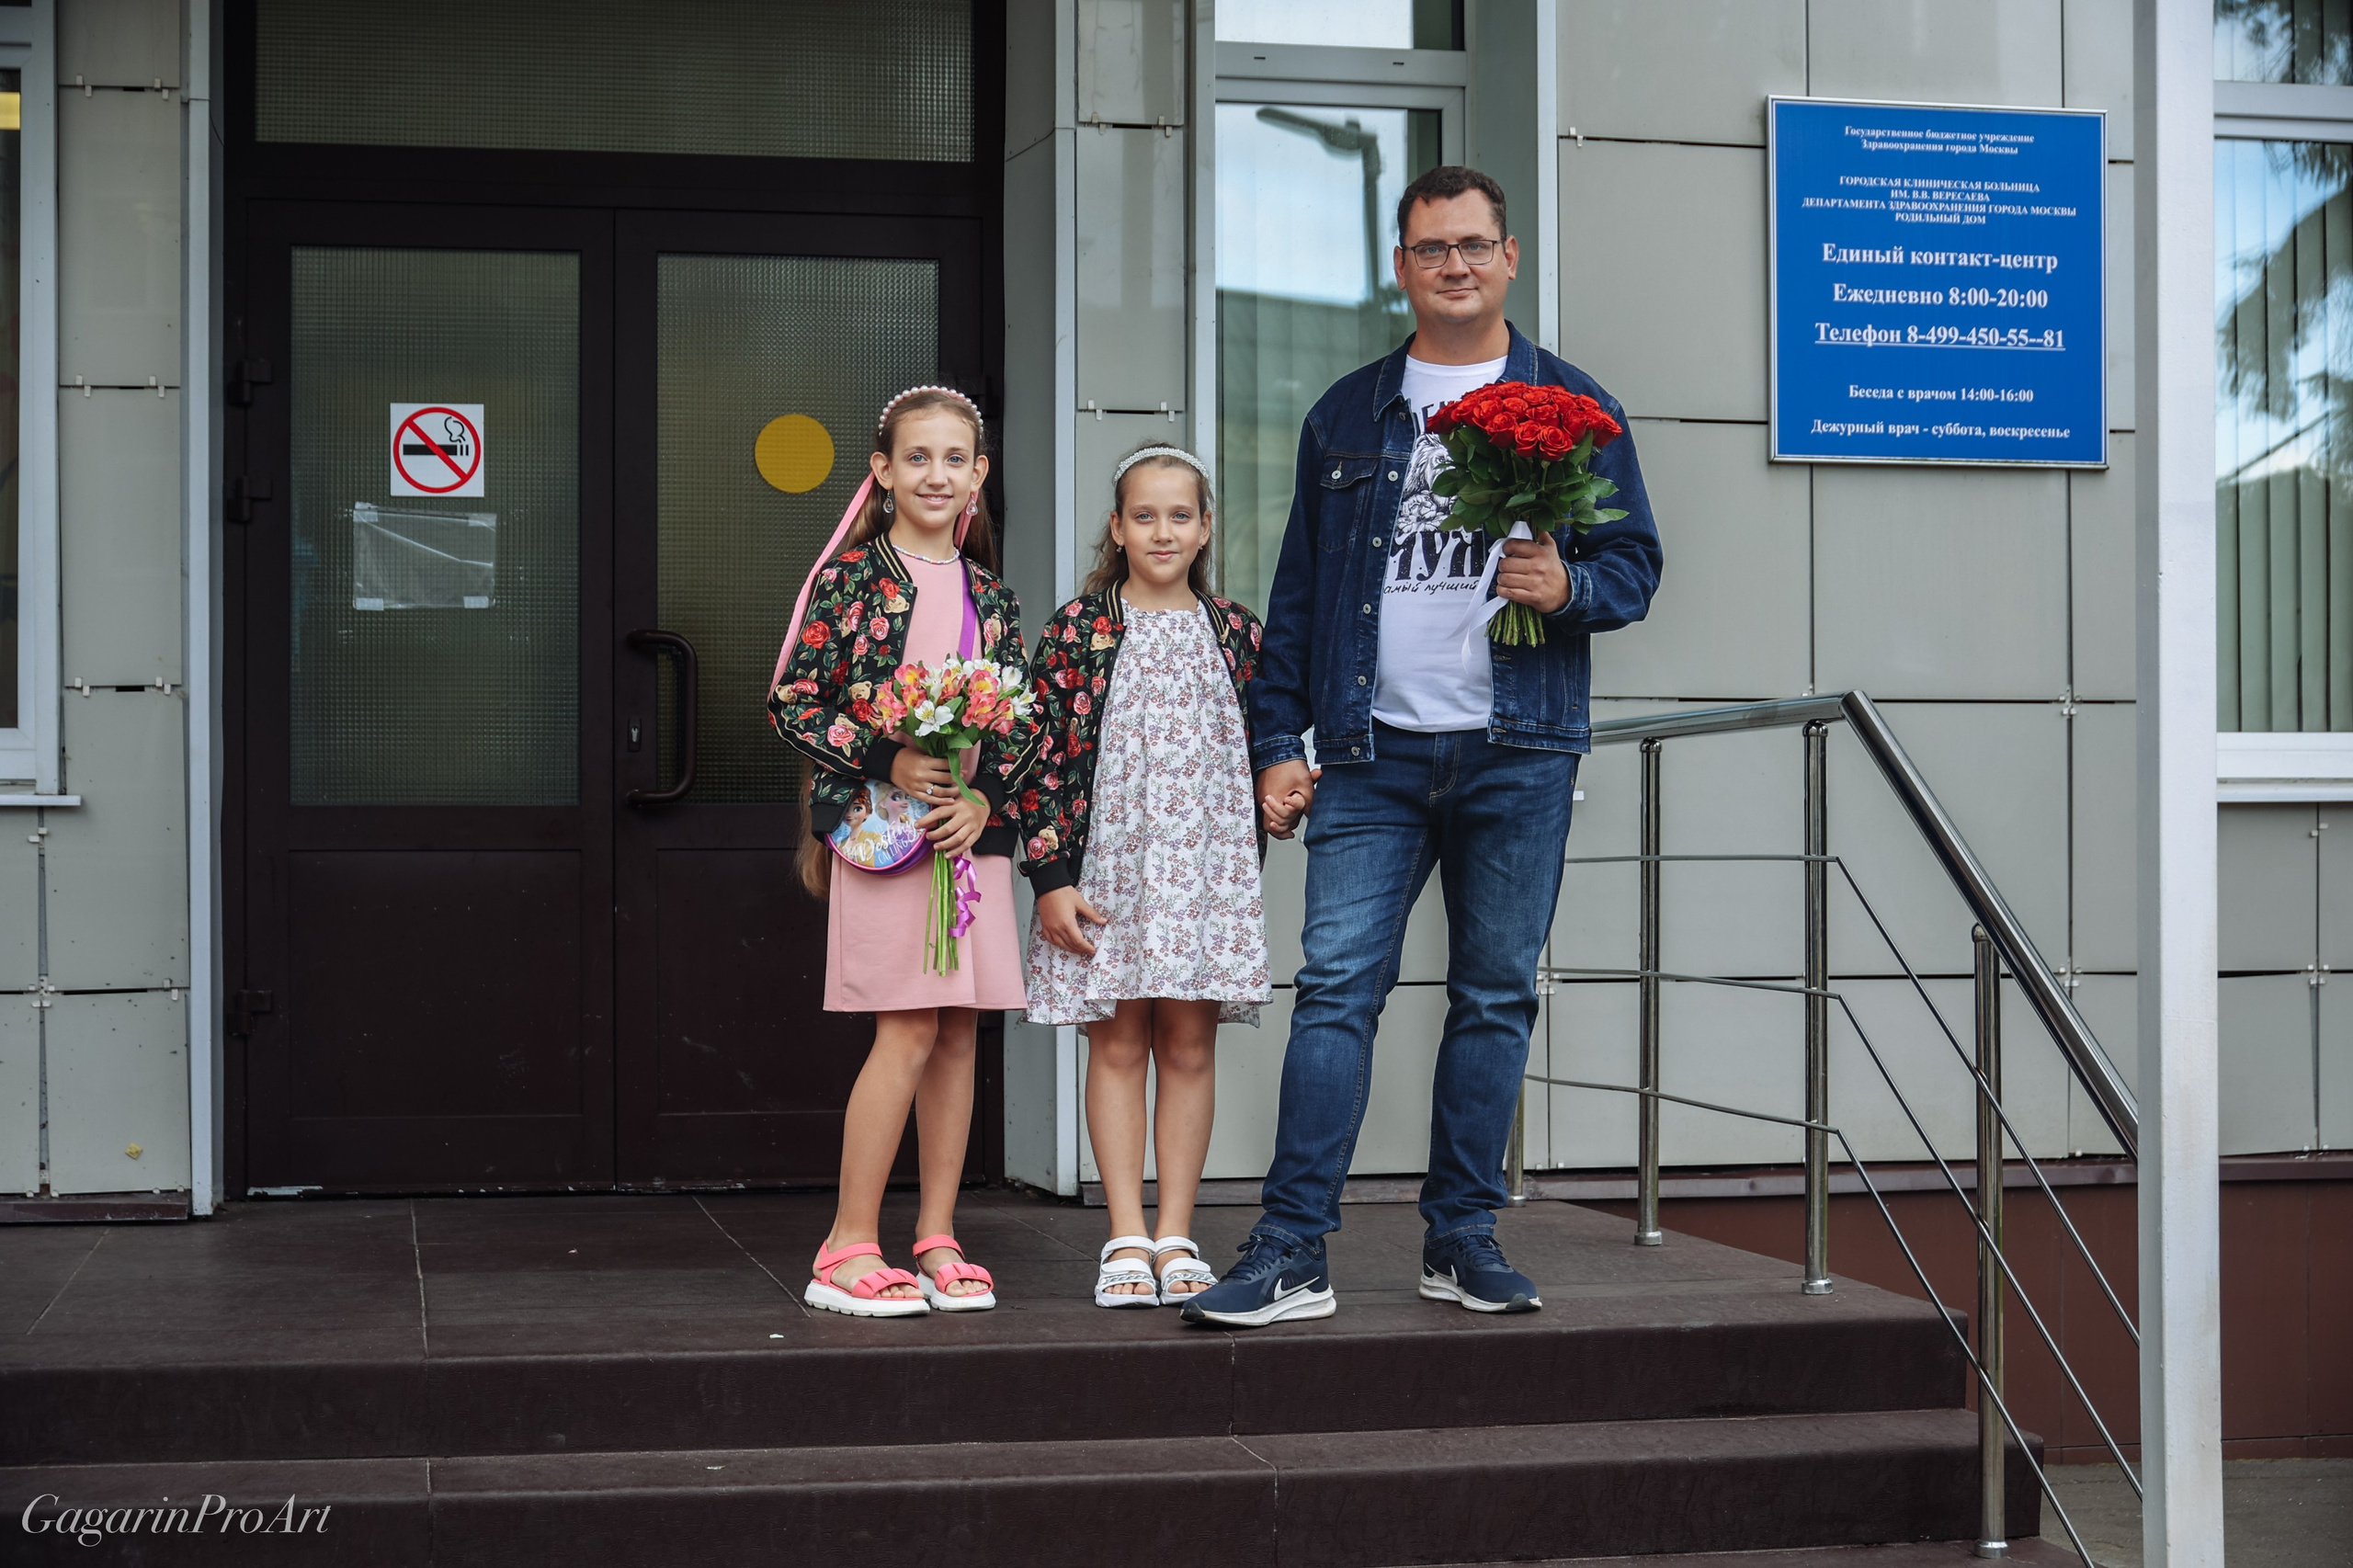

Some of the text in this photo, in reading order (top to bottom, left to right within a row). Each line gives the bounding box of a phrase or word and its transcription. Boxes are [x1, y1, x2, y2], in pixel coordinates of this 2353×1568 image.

[1844, 125, 2035, 143] Государственное бюджетное учреждение
[1860, 139, 2018, 154] Здравоохранения города Москвы
[1839, 176, 2040, 193] ГОРОДСКАЯ КЛИНИЧЕСКАЯ БОЛЬНИЦА
[1891, 188, 1991, 201] ИМ. В.В. ВЕРЕСАЕВА
[1802, 197, 2076, 217] ДЕПАРТАМЕНТА ЗДРАВООХРАНЕНИЯ ГОРОДА МОСКВЫ
[1894, 212, 1986, 225] РОДИЛЬНЫЙ ДОМ
[1822, 243, 2058, 275] Единый контакт-центр
[1833, 283, 2049, 308] Ежедневно 8:00-20:00
[1814, 322, 2065, 349] Телефон 8-499-450-55--81
[1848, 384, 2034, 403] Беседа с врачом 14:00-16:00
[1810, 419, 1884, 436] Дежурный
[1888, 424, 1920, 437] врач
[1931, 423, 1986, 439] суббота,
[1989, 426, 2071, 440] воскресенье
[1383, 581, 1421, 595] амый
